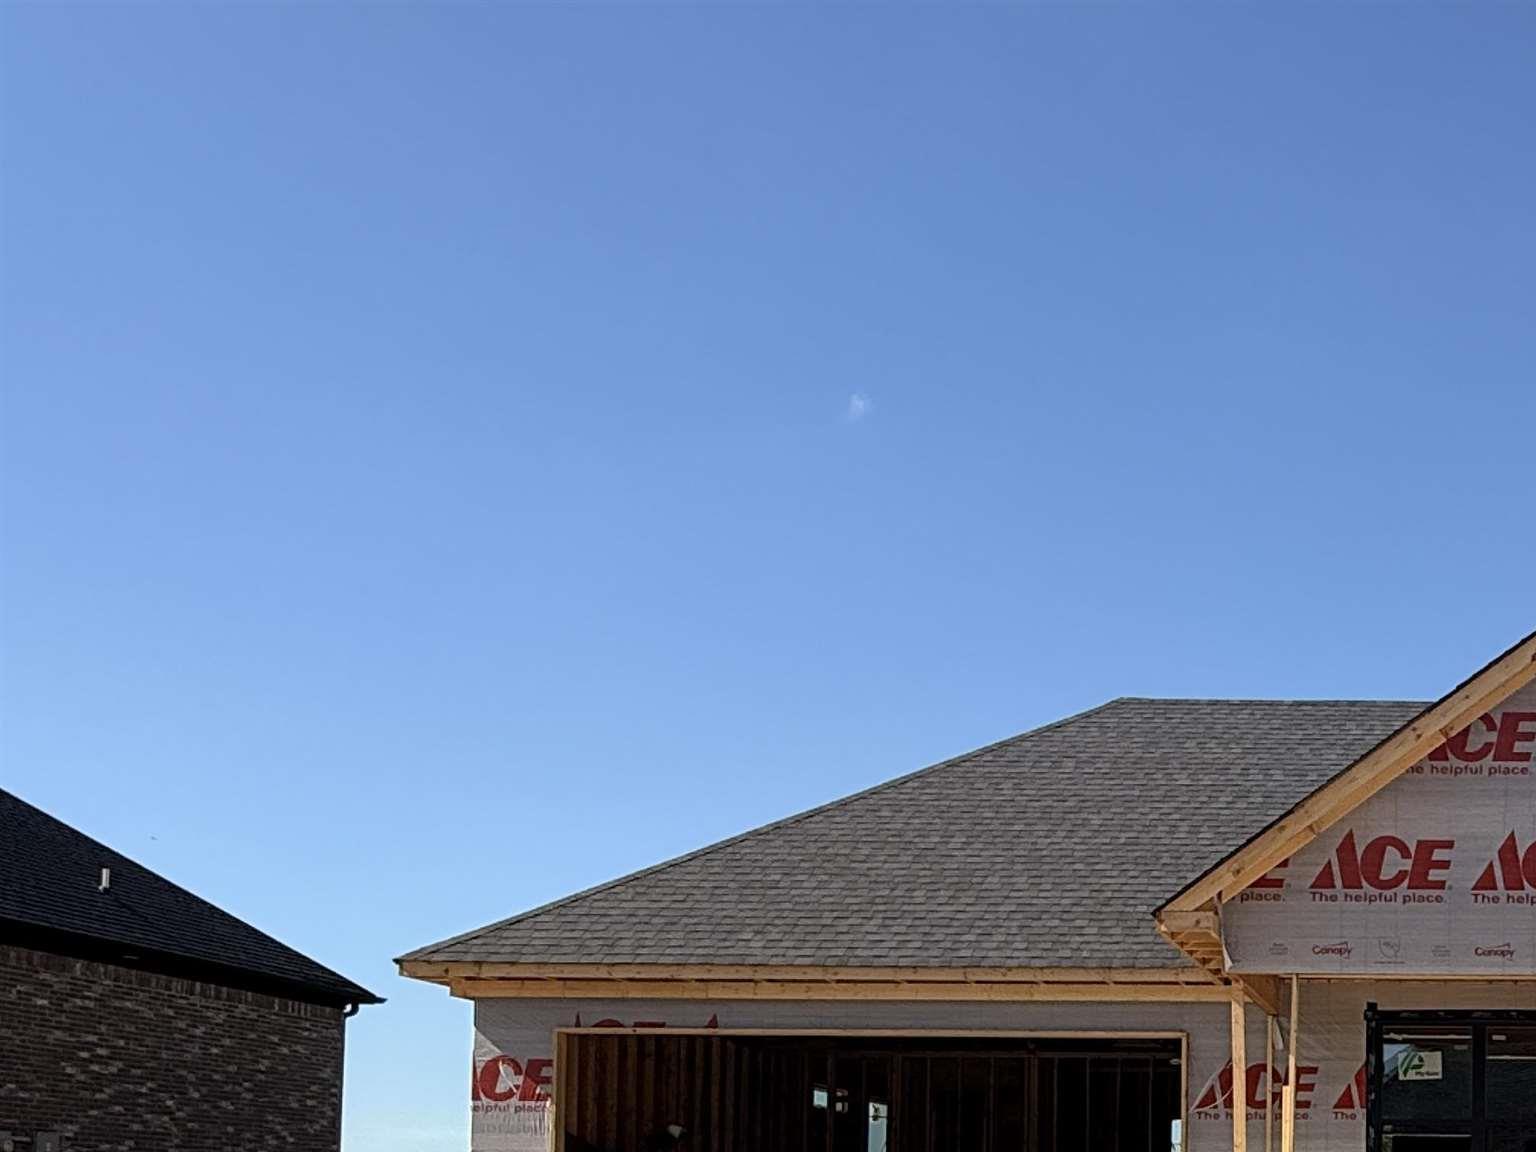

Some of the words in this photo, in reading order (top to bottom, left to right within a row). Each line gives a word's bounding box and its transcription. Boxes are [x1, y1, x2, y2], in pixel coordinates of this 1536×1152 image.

[1430, 764, 1483, 777] helpful
[1309, 828, 1456, 891] ACE
[1310, 891, 1338, 903] The
[1344, 891, 1398, 905] helpful
[1472, 893, 1500, 904] The
[472, 1054, 552, 1102] CE
[1196, 1111, 1220, 1120] The
[1333, 1111, 1357, 1121] The
